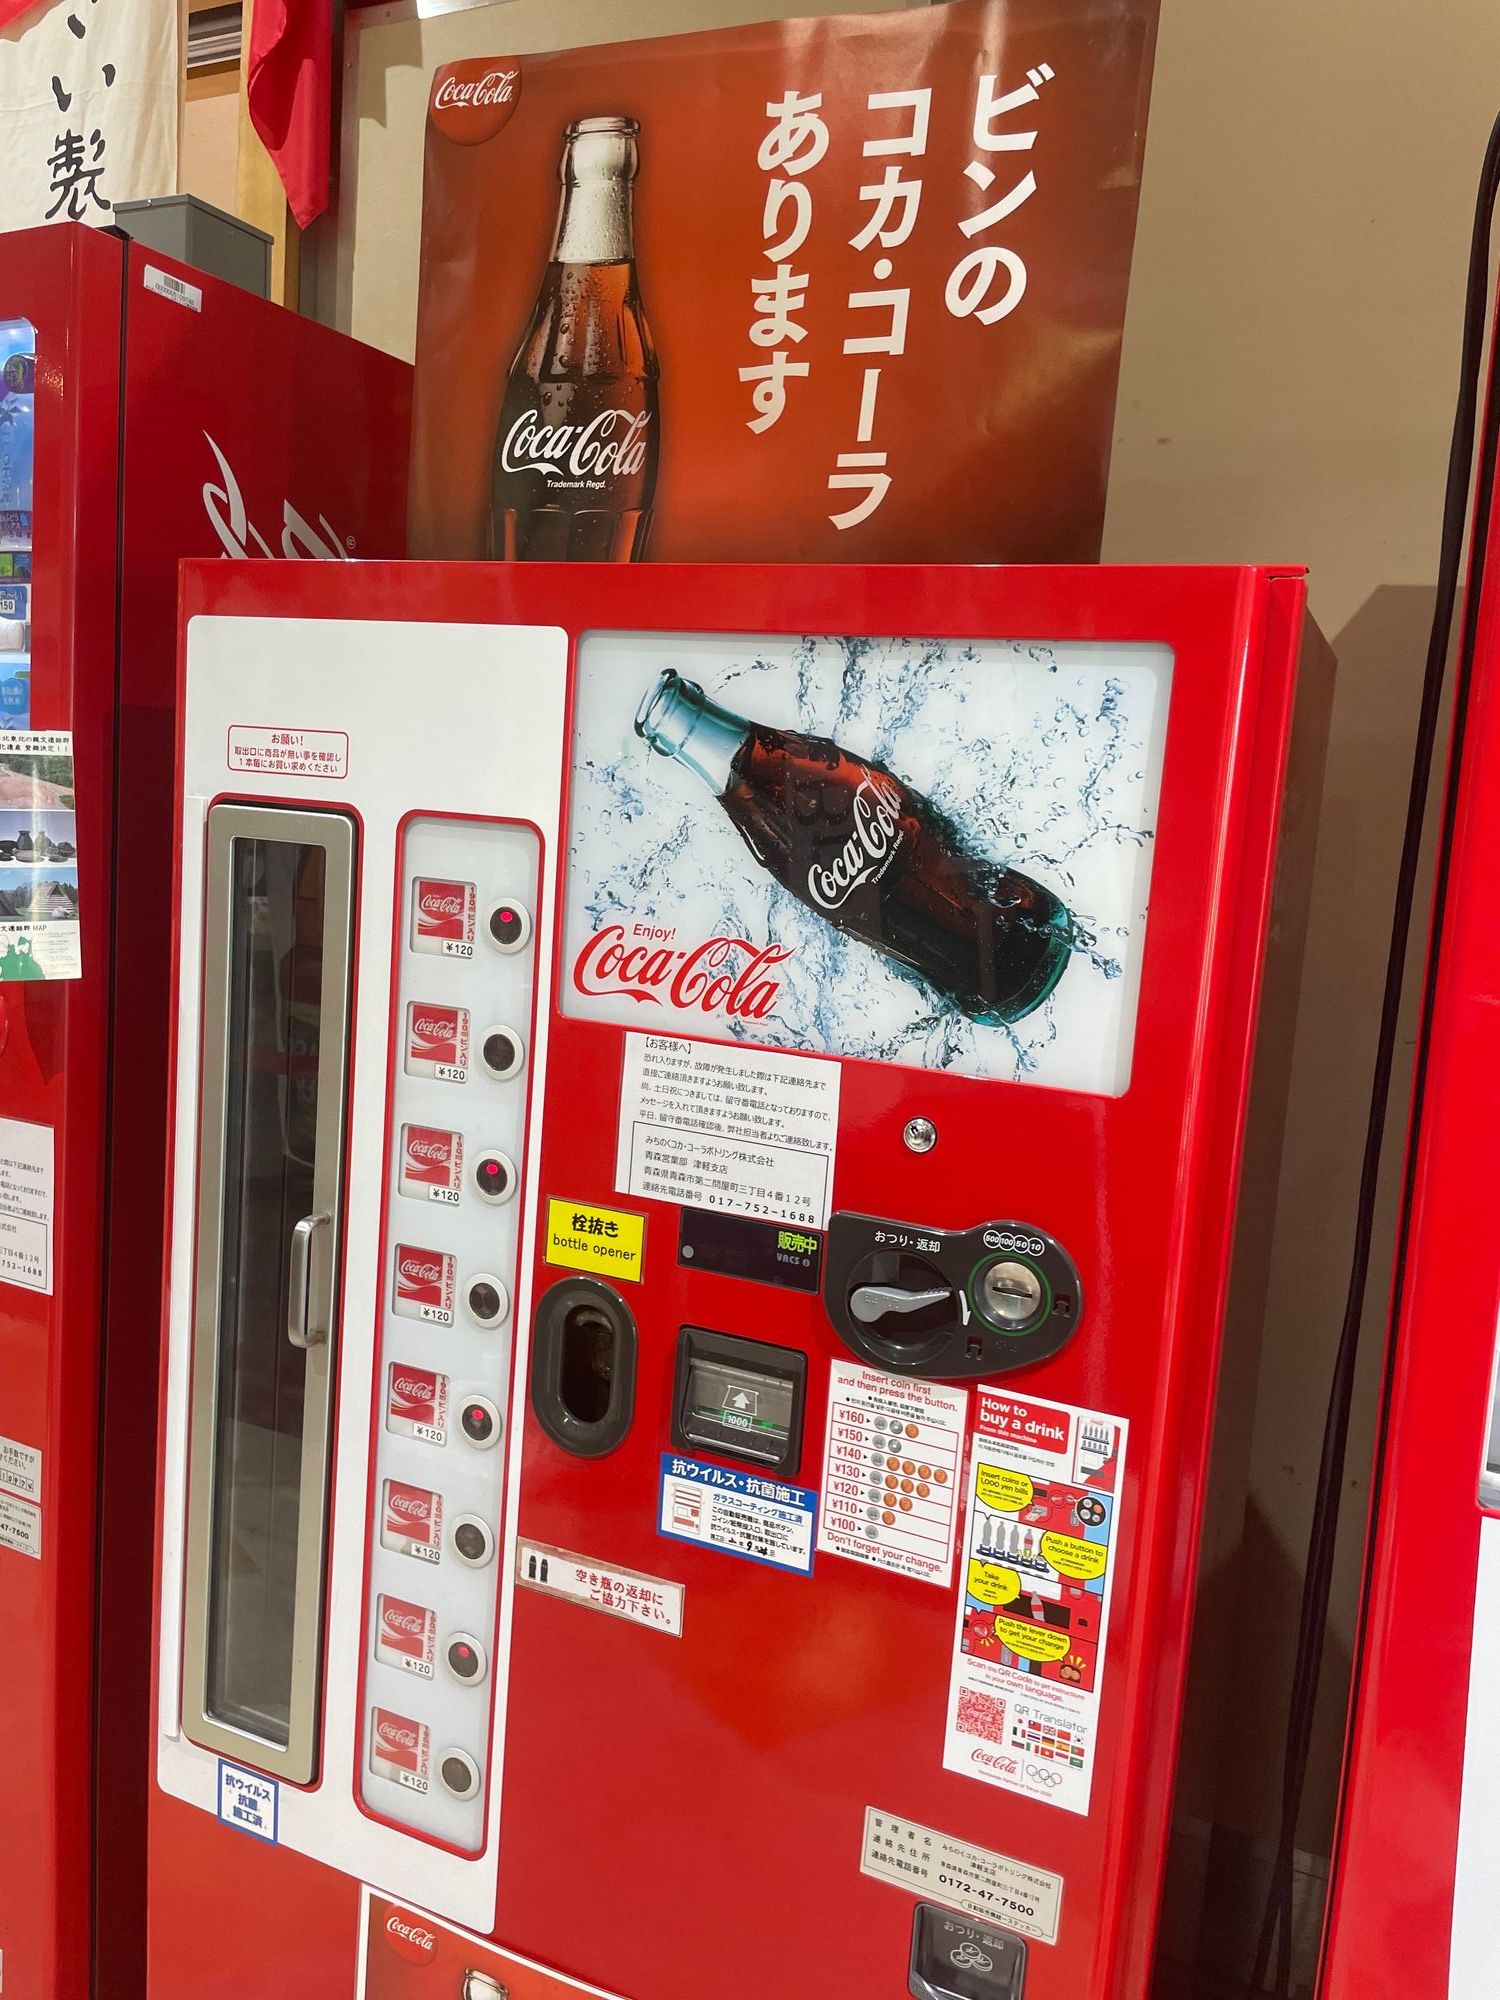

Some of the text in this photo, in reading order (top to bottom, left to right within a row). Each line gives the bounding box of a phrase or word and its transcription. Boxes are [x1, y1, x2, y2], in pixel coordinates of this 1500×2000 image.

[435, 71, 519, 109] Coca-Cola
[945, 62, 1056, 326] ビンの
[738, 91, 830, 435] あります
[827, 87, 933, 531] コカ・コーラ
[502, 409, 652, 476] Coca-Cola
[547, 480, 584, 488] Trademark
[808, 763, 902, 909] Coca-Cola
[871, 850, 897, 884] Trademark
[421, 894, 464, 914] Coca-Cola
[633, 923, 677, 941] Enjoy!
[446, 942, 473, 956] ¥120
[573, 925, 798, 1019] Coca-Cola
[414, 1018, 457, 1038] Coca-Cola
[645, 1037, 692, 1054] 【お客様へ】
[438, 1067, 465, 1080] ¥120
[409, 1140, 449, 1160] Coca-Cola
[693, 1159, 728, 1175] 津軽支店
[433, 1188, 460, 1202] ¥120
[642, 1181, 815, 1224] 連絡先電話番号 017-752-1688
[572, 1213, 619, 1238] 栓抜き
[553, 1233, 636, 1261] bottle opener
[777, 1230, 818, 1255] 販売中
[874, 1230, 941, 1253] おつり・返却
[985, 1234, 1042, 1251] 500 100 50 10
[401, 1259, 440, 1280] Coca-Cola
[424, 1307, 449, 1322] ¥120
[394, 1377, 434, 1400] Coca-Cola
[862, 1371, 932, 1395] Insert coin first
[838, 1377, 855, 1387] and
[857, 1380, 877, 1392] then
[880, 1386, 905, 1400] press
[907, 1392, 923, 1403] the
[924, 1396, 958, 1412] button.
[839, 1410, 865, 1424] ¥160
[981, 1397, 1028, 1417] How to
[728, 1415, 748, 1428] 1000
[980, 1408, 1065, 1441] buy a drink
[417, 1426, 442, 1442] ¥120
[837, 1427, 863, 1442] ¥150
[836, 1445, 861, 1460] ¥140
[835, 1463, 860, 1478] ¥130
[981, 1470, 1000, 1480] Insert
[671, 1458, 806, 1507] 抗ウイルス・抗菌施工
[833, 1481, 859, 1496] ¥120
[1000, 1484, 1014, 1493] yen
[1014, 1486, 1029, 1496] bills
[832, 1499, 857, 1514] ¥110
[831, 1516, 855, 1532] ¥100
[827, 1532, 852, 1546] Don't
[853, 1539, 880, 1555] forget
[883, 1548, 904, 1561] your
[905, 1554, 943, 1573] change.
[1069, 1543, 1094, 1555] button
[1080, 1553, 1099, 1563] drink
[575, 1568, 663, 1605] 空き瓶の返却に
[990, 1580, 1008, 1591] drink
[590, 1589, 672, 1625] ご協力下さい。
[1008, 1629, 1021, 1639] get
[1022, 1632, 1039, 1643] your
[1039, 1636, 1065, 1650] change
[998, 1667, 1011, 1678] QR
[1012, 1670, 1033, 1684] Code
[1014, 1704, 1087, 1734] QR Translator
[971, 1748, 1019, 1774] Coca-Cola
[225, 1773, 271, 1802] 抗ウイルス
[939, 1874, 1034, 1917] 0172-47-7500
[386, 1916, 436, 1951] Coca-Cola
[943, 1921, 1005, 1950] おつり・返却
